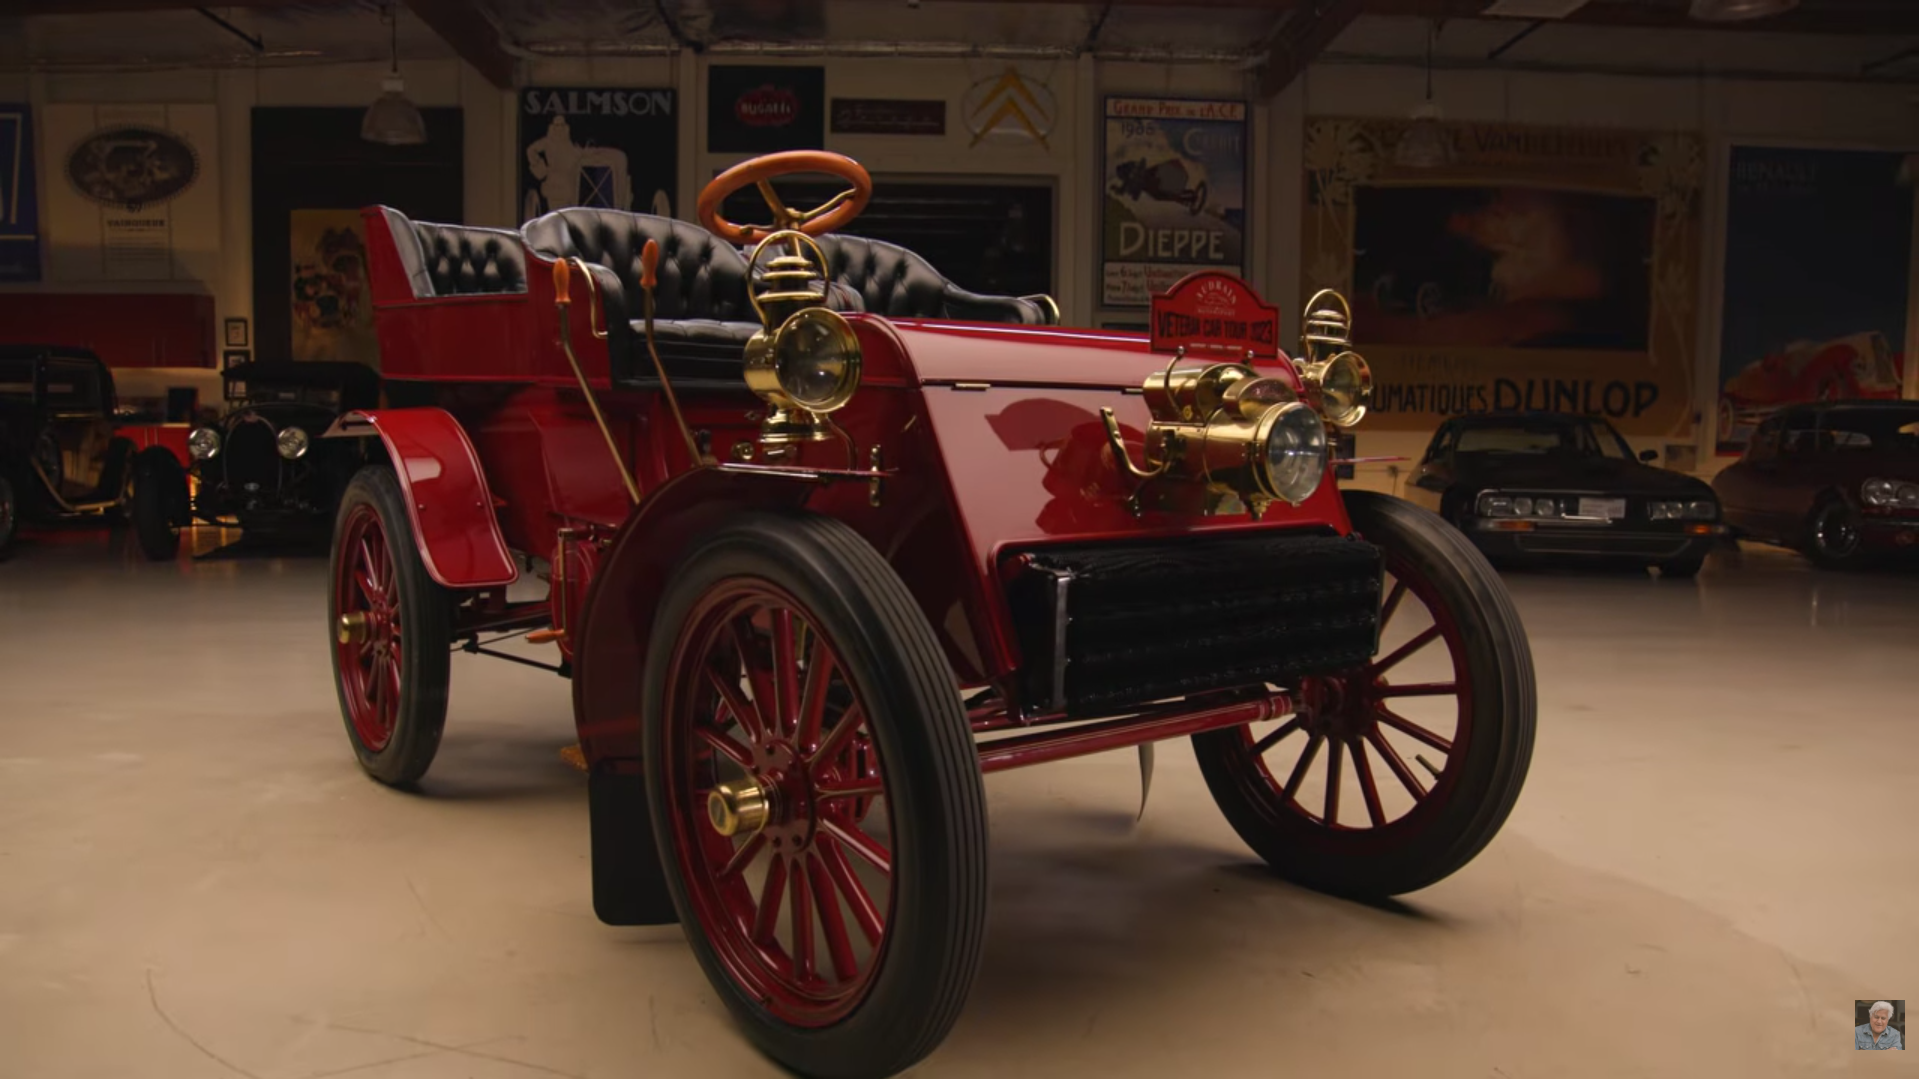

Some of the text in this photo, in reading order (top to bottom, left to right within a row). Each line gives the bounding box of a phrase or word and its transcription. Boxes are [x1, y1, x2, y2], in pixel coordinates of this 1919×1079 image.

[524, 90, 673, 116] SALMSON
[741, 102, 791, 115] BUGATTI
[1119, 221, 1225, 260] DIEPPE
[1157, 309, 1201, 338] VETERAN
[1203, 319, 1222, 338] CAR
[1224, 320, 1247, 340] TOUR
[1493, 377, 1660, 418] DUNLOP
